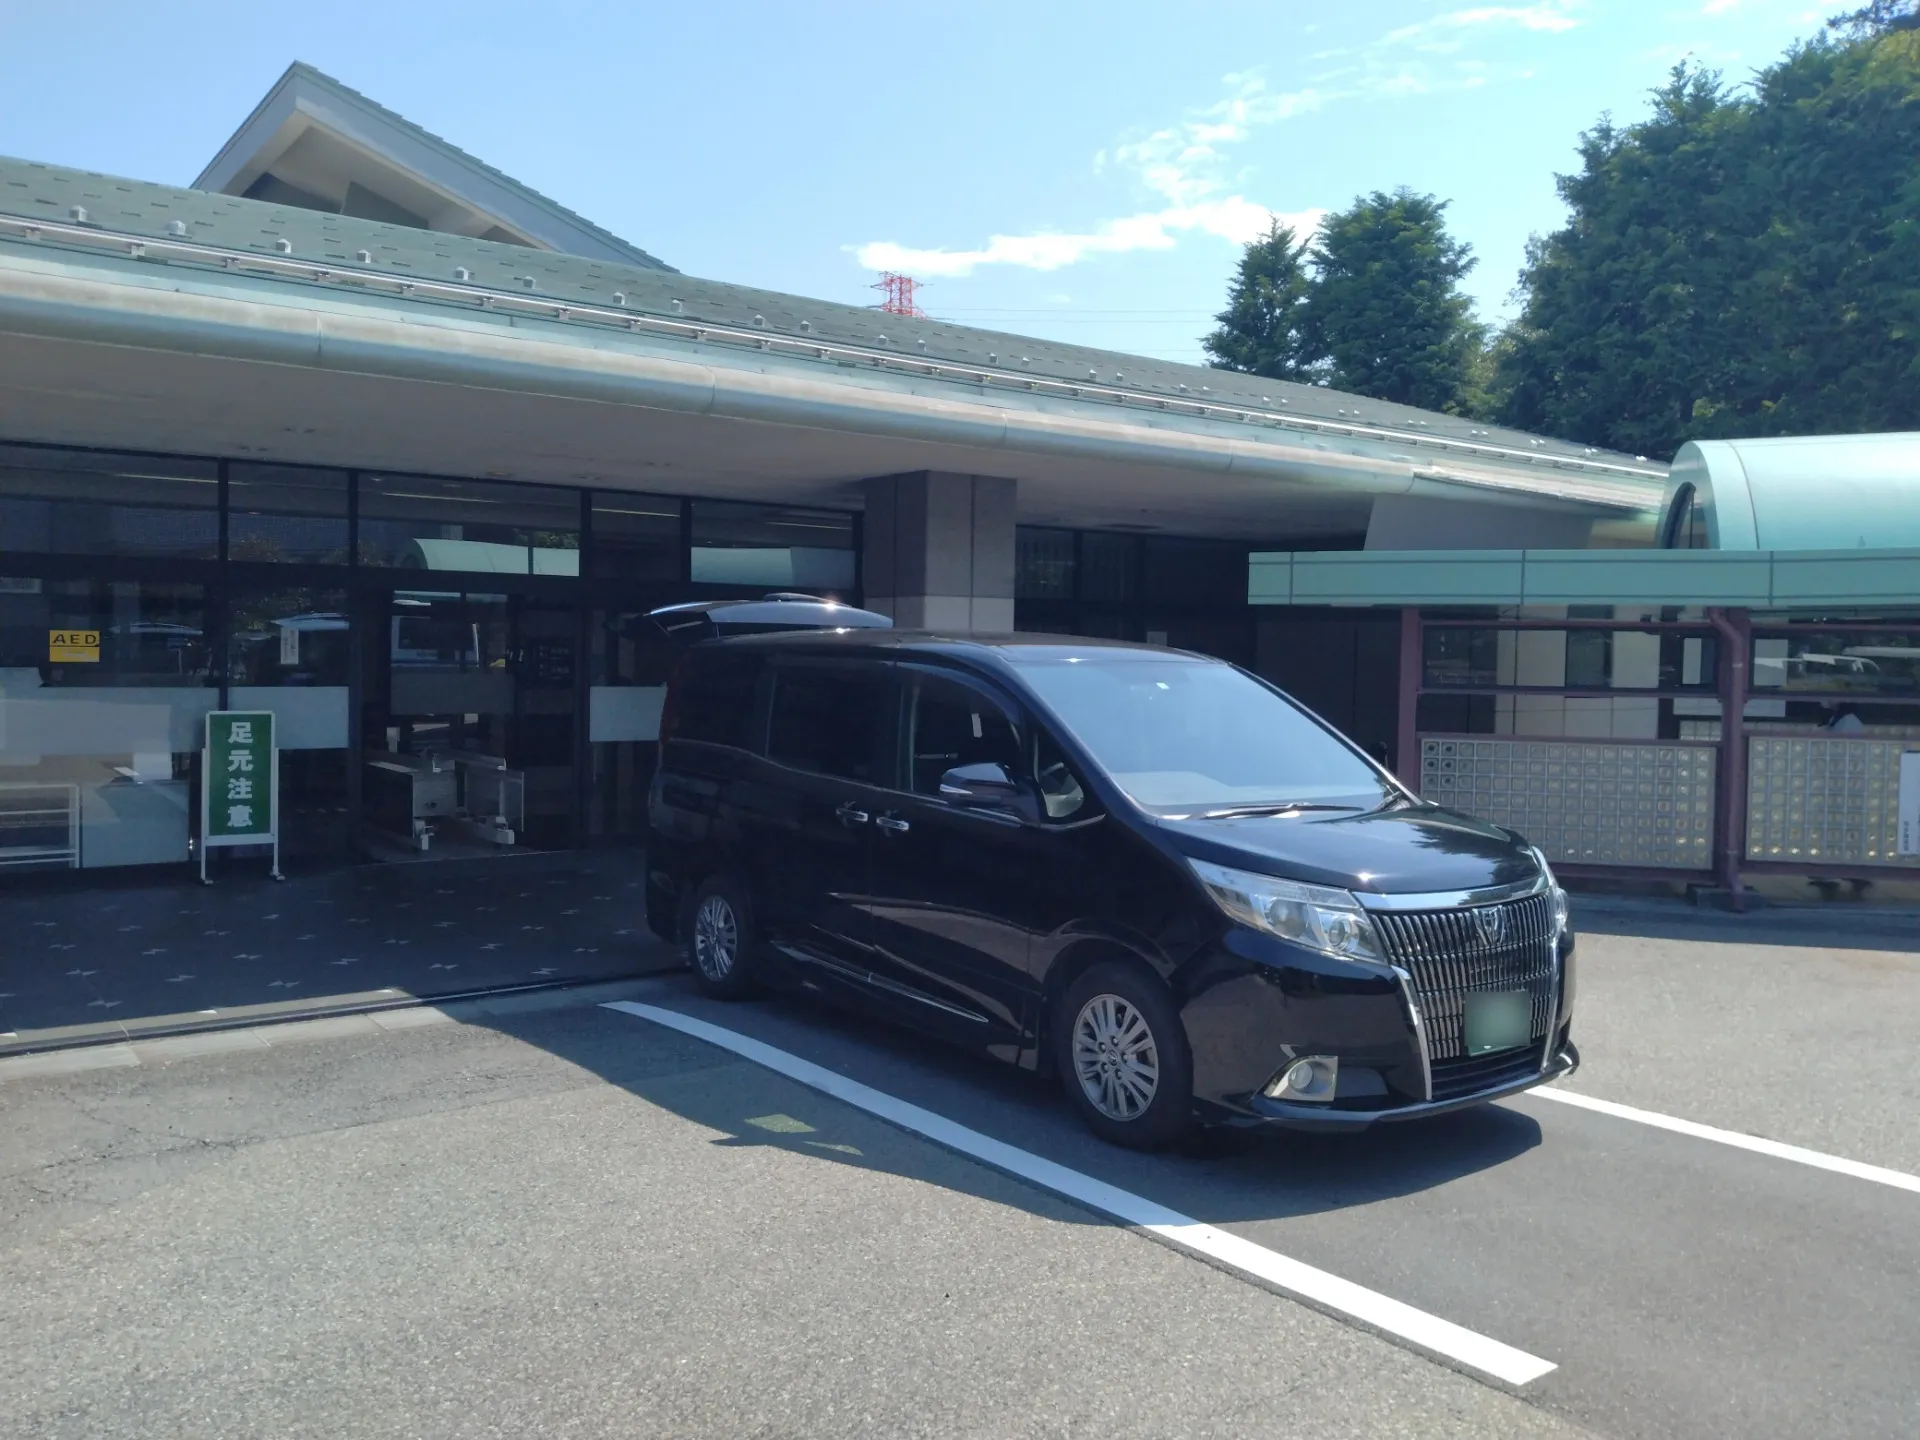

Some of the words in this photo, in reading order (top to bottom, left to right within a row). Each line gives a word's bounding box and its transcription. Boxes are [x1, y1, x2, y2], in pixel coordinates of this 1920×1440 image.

[52, 633, 97, 645] AED
[227, 721, 254, 828] 足元注意
